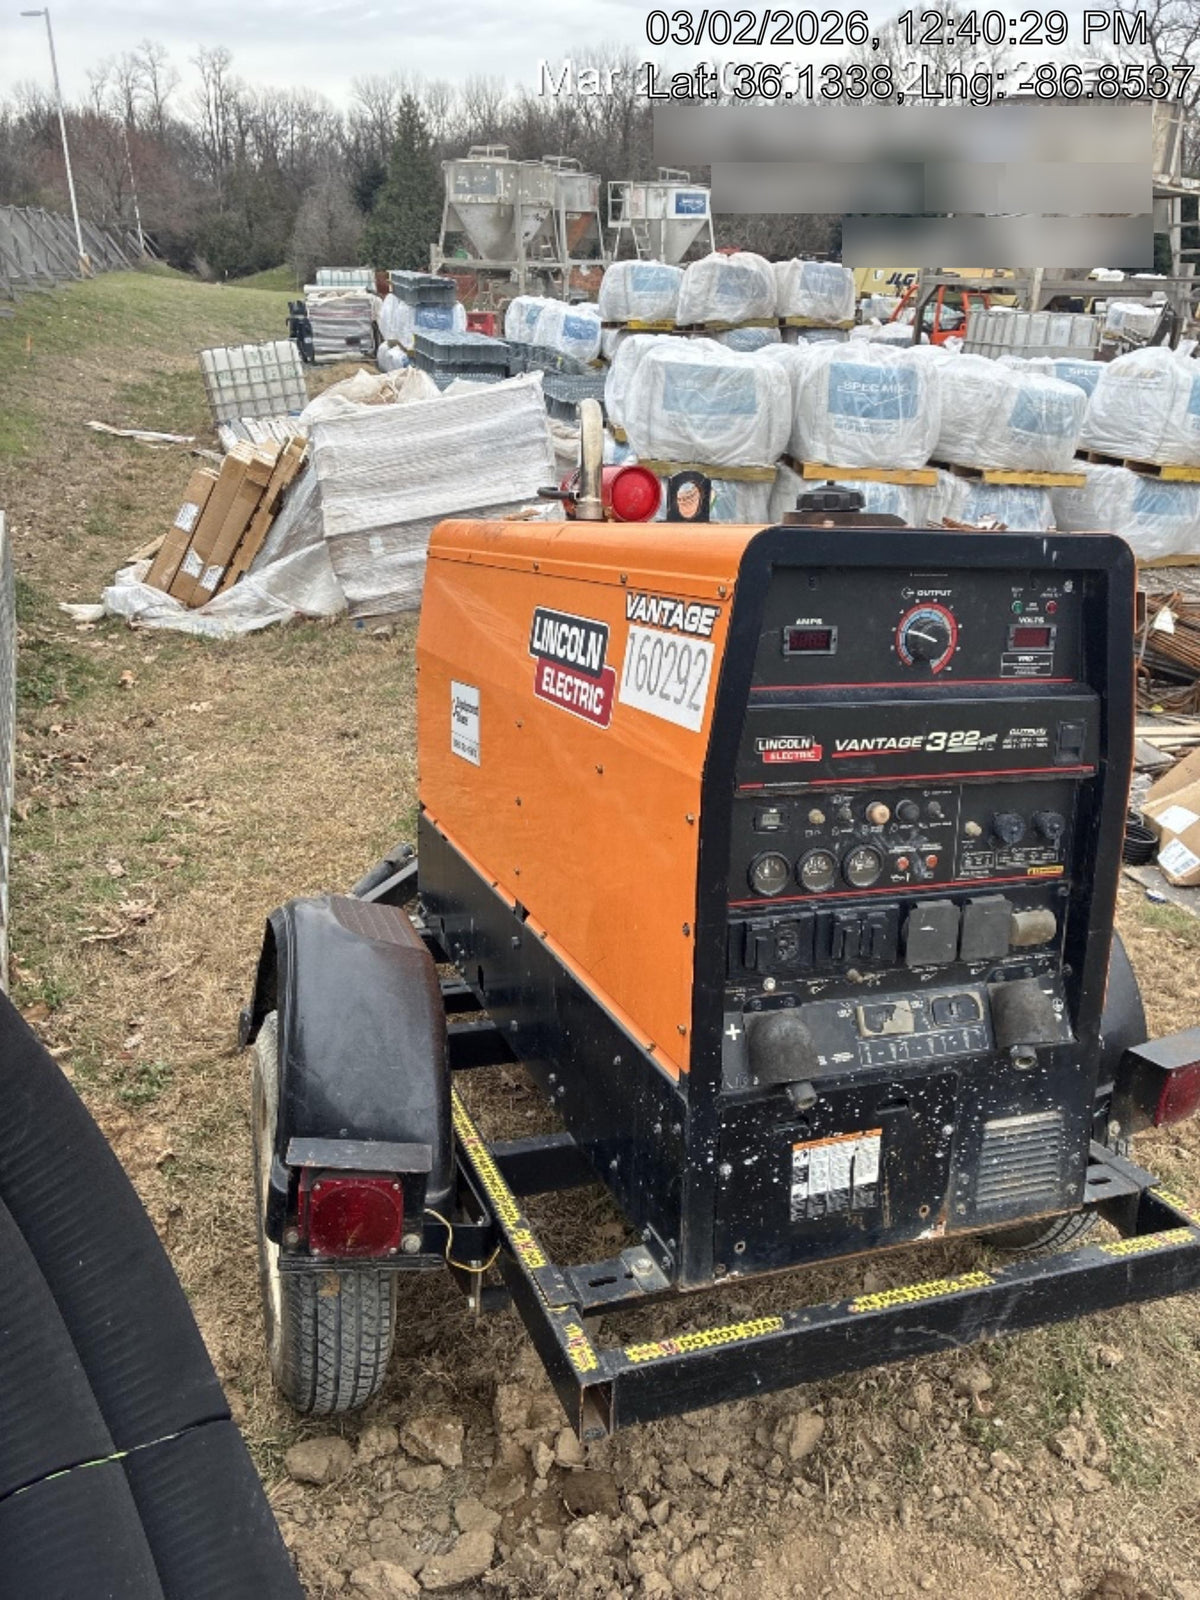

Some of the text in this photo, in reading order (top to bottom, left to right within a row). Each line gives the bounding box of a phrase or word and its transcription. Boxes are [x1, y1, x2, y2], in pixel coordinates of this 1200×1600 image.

[885, 272, 916, 287] JLG
[917, 589, 952, 597] OUTPUT
[626, 593, 715, 635] VANTAGE
[1018, 616, 1045, 624] VOLTS
[532, 616, 604, 671] LINCOLN
[624, 631, 708, 712] 160292
[541, 666, 605, 716] ELECTRIC
[758, 737, 812, 751] LINCOLN
[834, 735, 923, 751] VANTAGE
[925, 730, 981, 752] 322
[769, 750, 816, 760] ELECTRIC
[679, 1336, 704, 1349] DO
[707, 1328, 739, 1343] NOT
